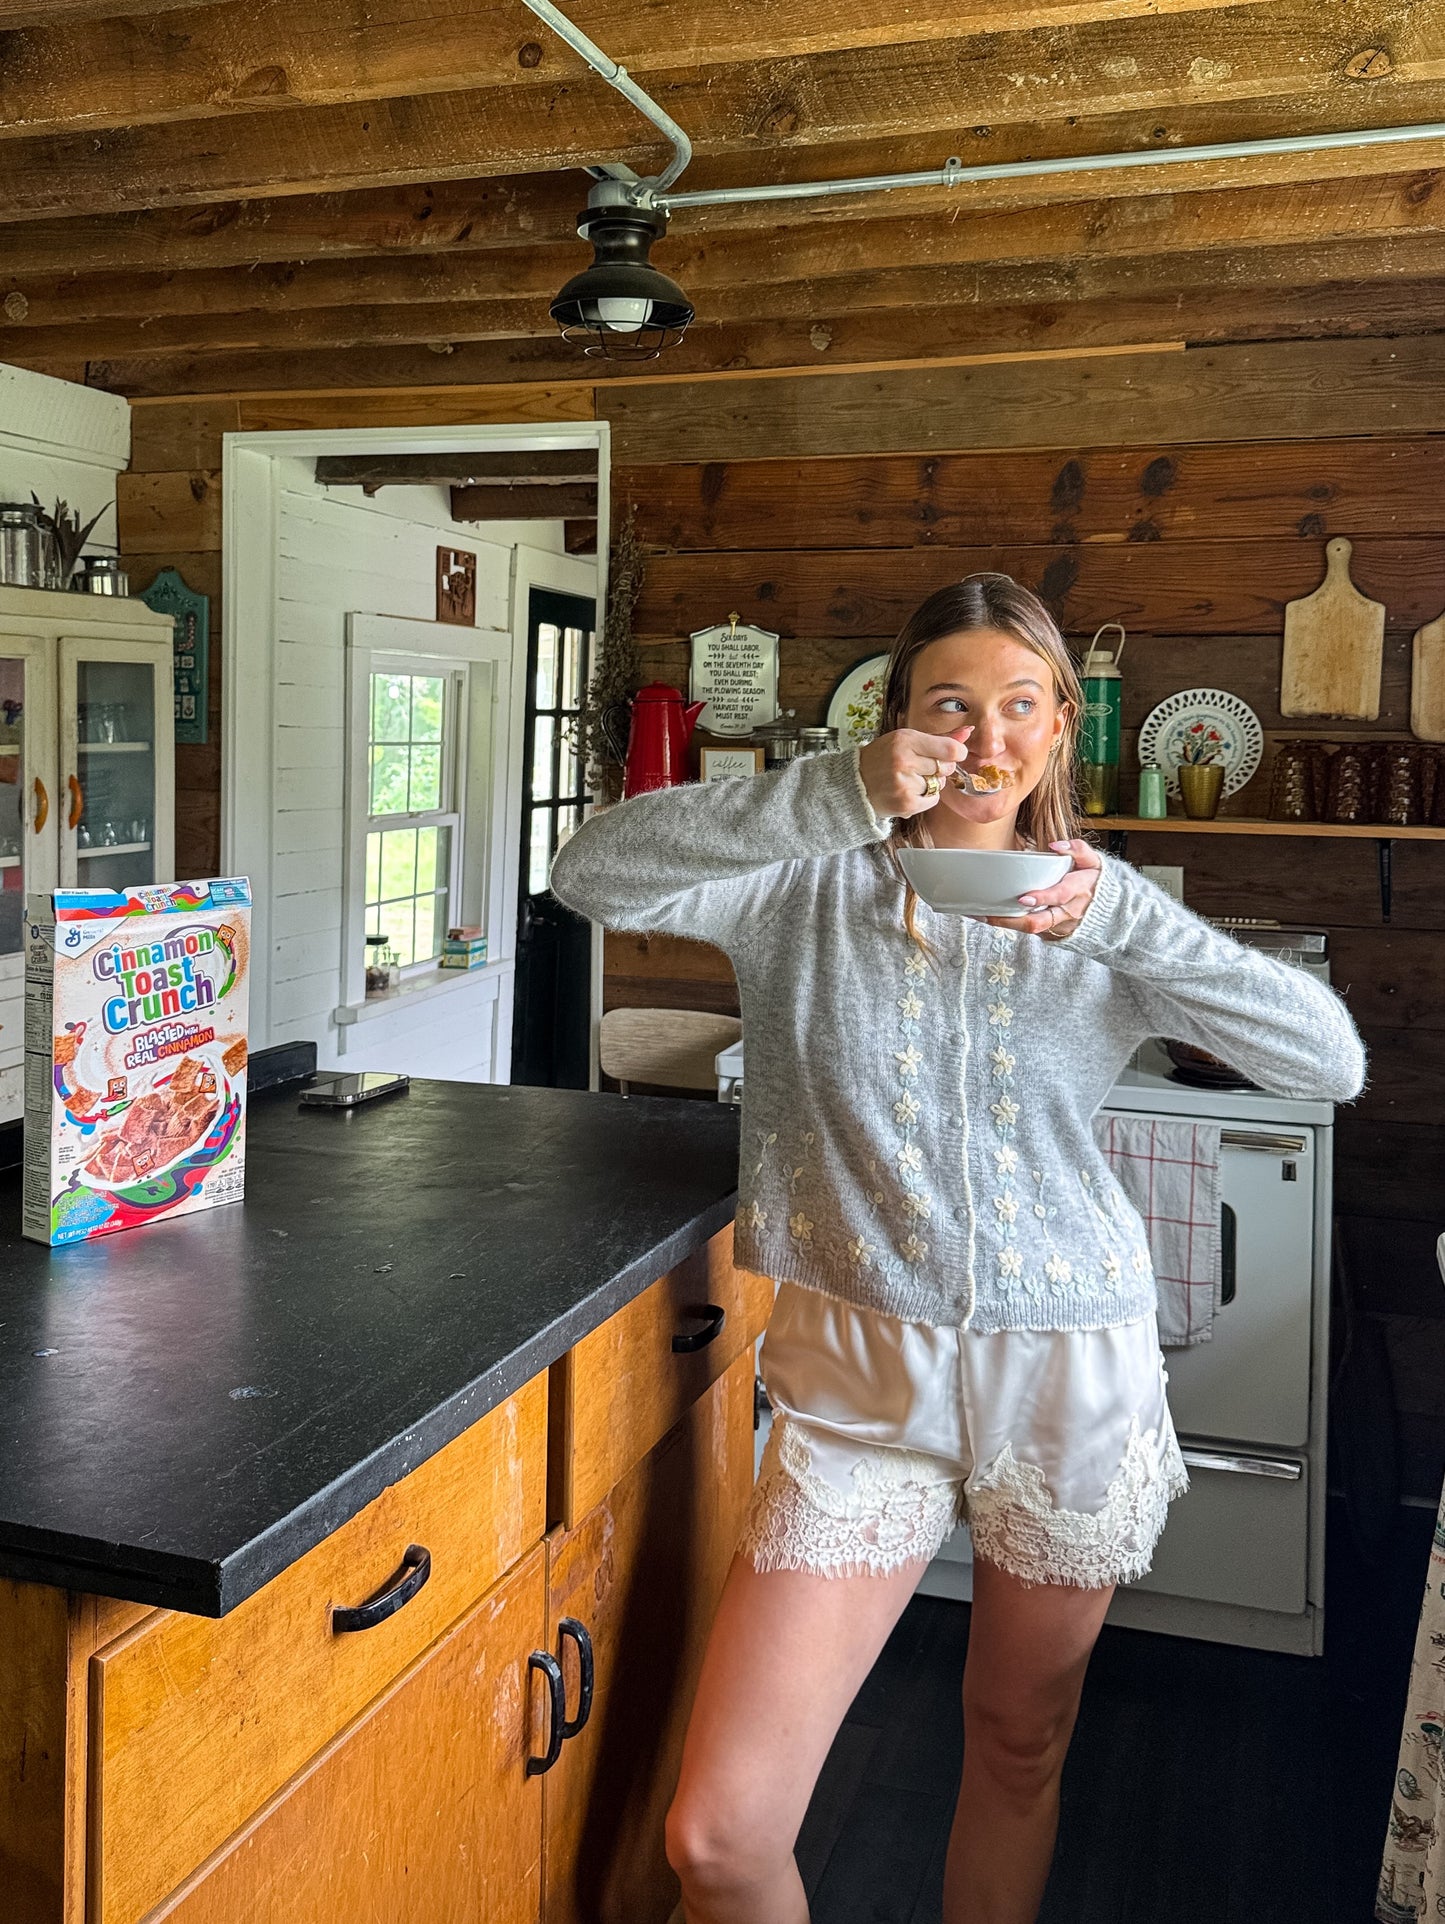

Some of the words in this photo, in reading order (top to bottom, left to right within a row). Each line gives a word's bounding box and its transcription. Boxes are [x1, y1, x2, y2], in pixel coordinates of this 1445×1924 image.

[708, 643, 720, 651] YOU
[725, 661, 751, 669] SEVENTH
[714, 687, 741, 695] PLOWING
[742, 687, 766, 695] SEASON
[740, 704, 754, 712] YOU
[715, 712, 733, 720] MUST
[712, 756, 747, 771] coffee
[138, 887, 171, 899] Cinnamon
[145, 893, 169, 903] Toast
[145, 898, 177, 911] Crunch
[98, 932, 212, 976] Cinnamon
[121, 956, 194, 998] Toast
[107, 973, 213, 1030] Crunch
[135, 1025, 185, 1052] BLASTED
[185, 1026, 198, 1036] WITH
[126, 1050, 158, 1068] REAL
[157, 1030, 213, 1058] CINNAMON
[57, 1232, 67, 1240] NET
